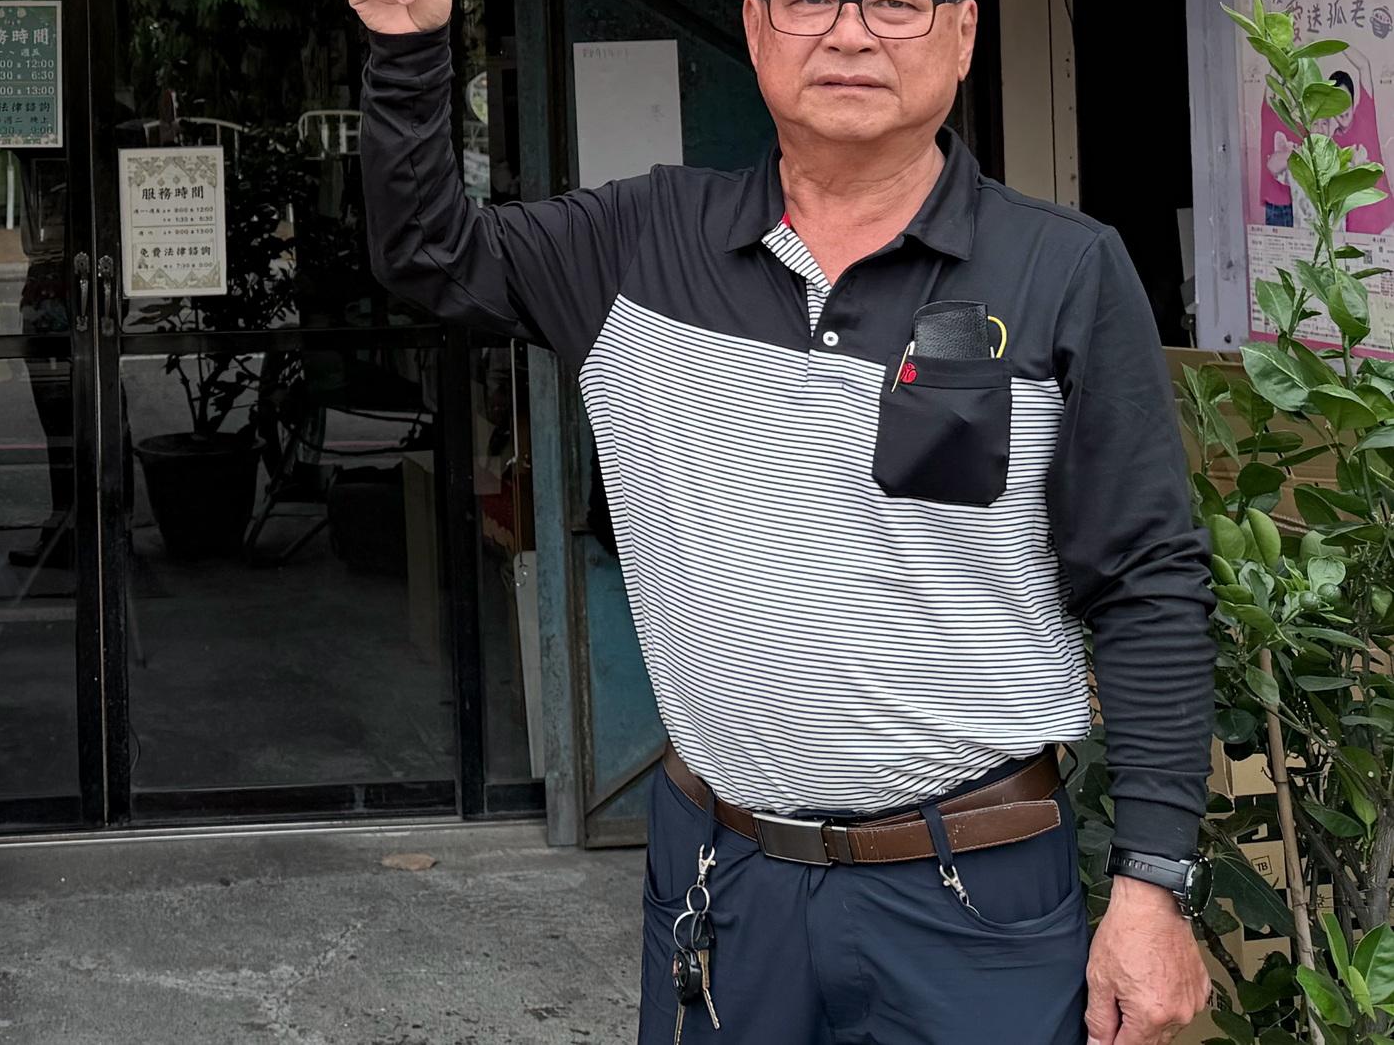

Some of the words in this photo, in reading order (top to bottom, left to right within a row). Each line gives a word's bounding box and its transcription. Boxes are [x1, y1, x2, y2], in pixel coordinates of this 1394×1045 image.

[26, 59, 55, 68] 12:00
[31, 71, 55, 80] 6:30
[142, 185, 204, 200] 服務時間
